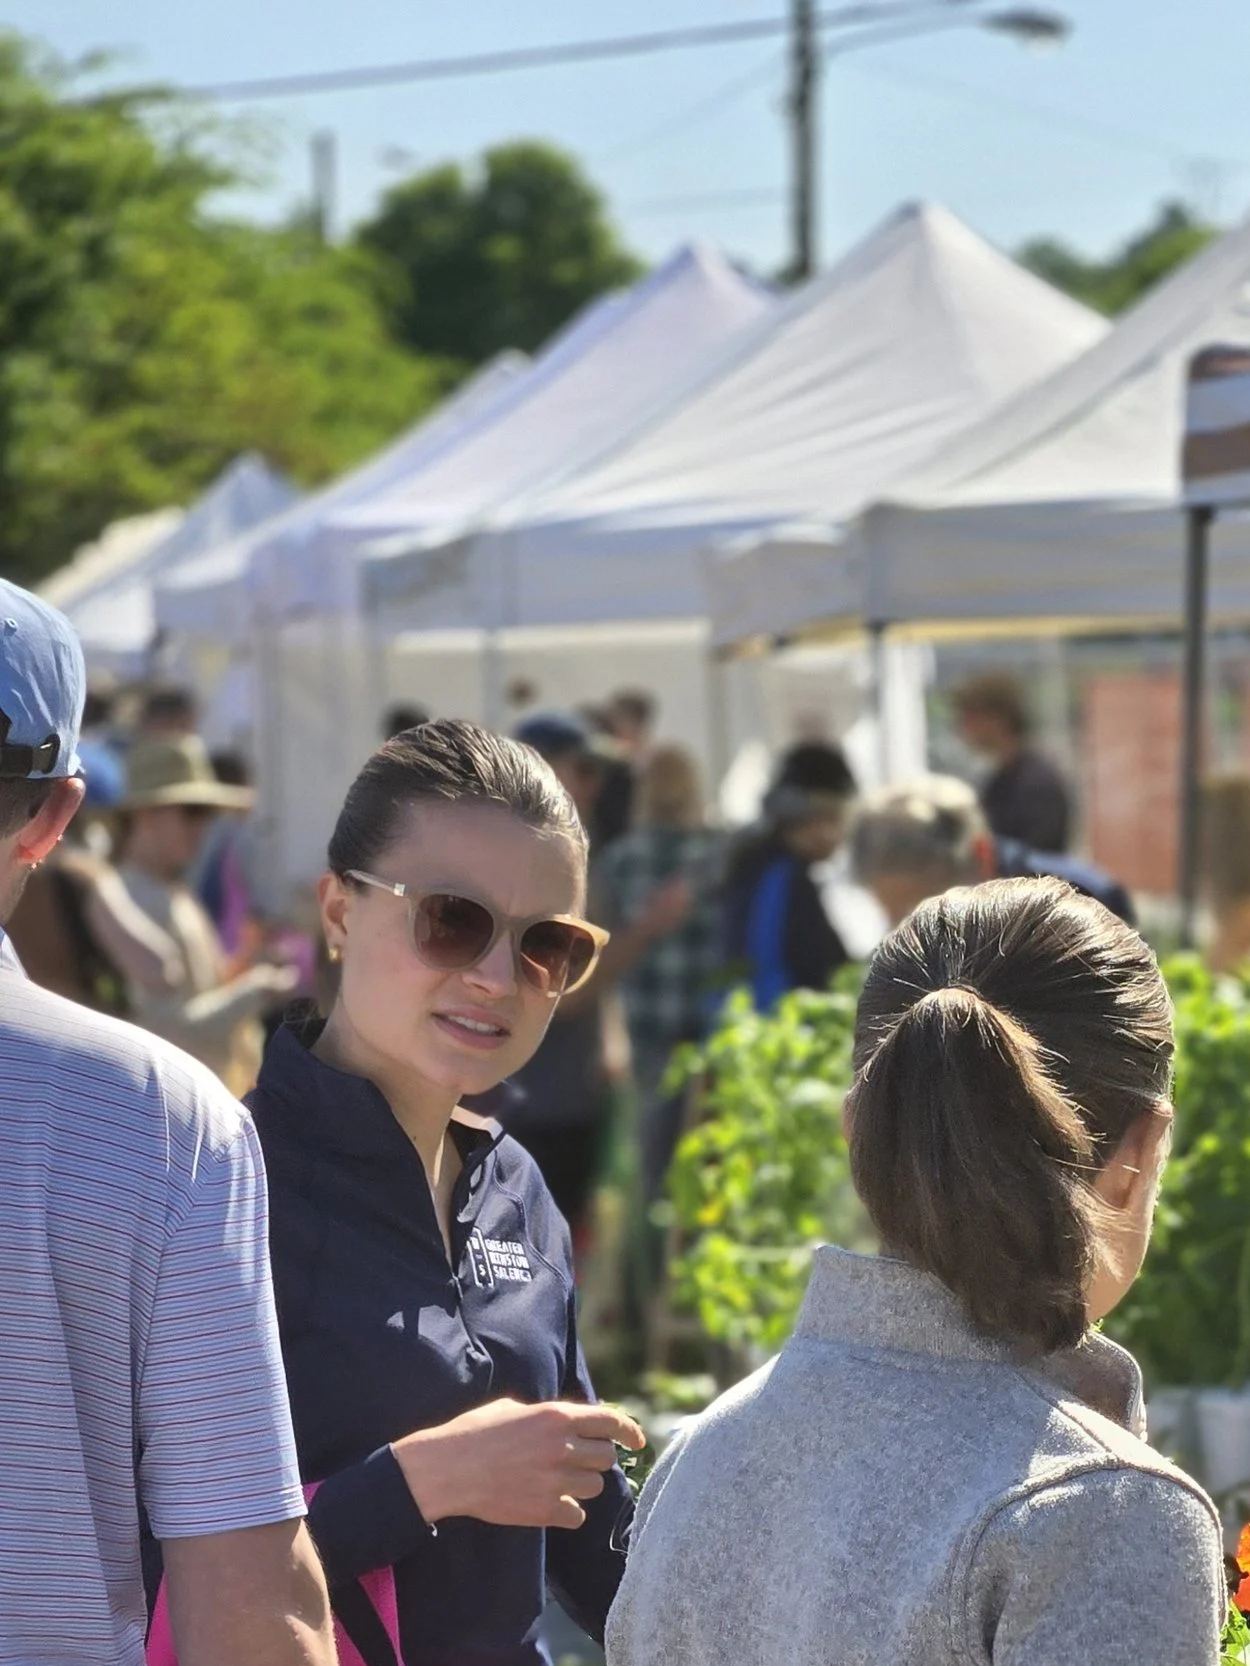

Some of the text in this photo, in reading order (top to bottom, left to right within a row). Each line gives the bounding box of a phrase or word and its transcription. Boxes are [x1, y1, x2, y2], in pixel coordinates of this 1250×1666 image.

[485, 1239, 525, 1255] GREATER
[489, 1252, 530, 1269] WINSTON
[493, 1265, 521, 1281] SALEM
